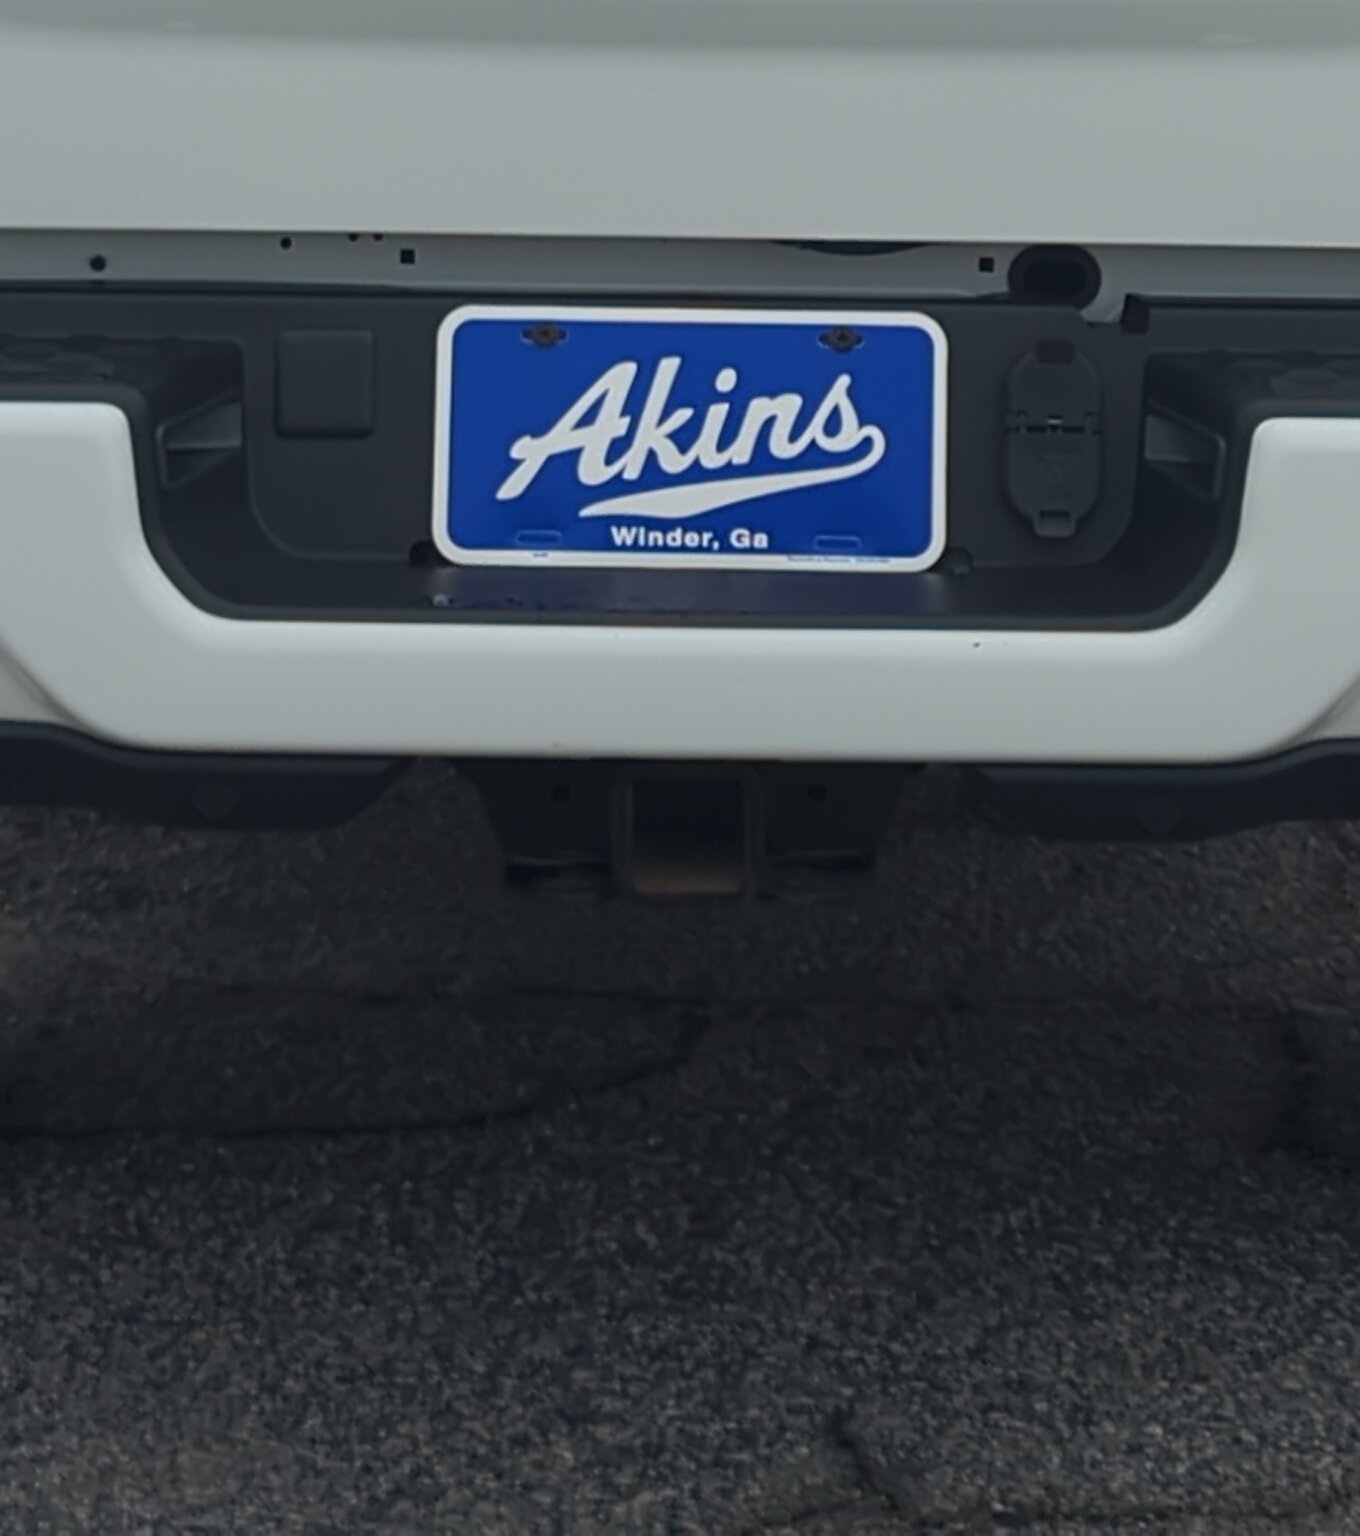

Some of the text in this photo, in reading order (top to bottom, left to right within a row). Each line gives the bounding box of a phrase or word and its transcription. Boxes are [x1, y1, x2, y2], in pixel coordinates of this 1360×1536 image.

[496, 356, 886, 518] Akins
[610, 526, 769, 550] Winder, Ga
